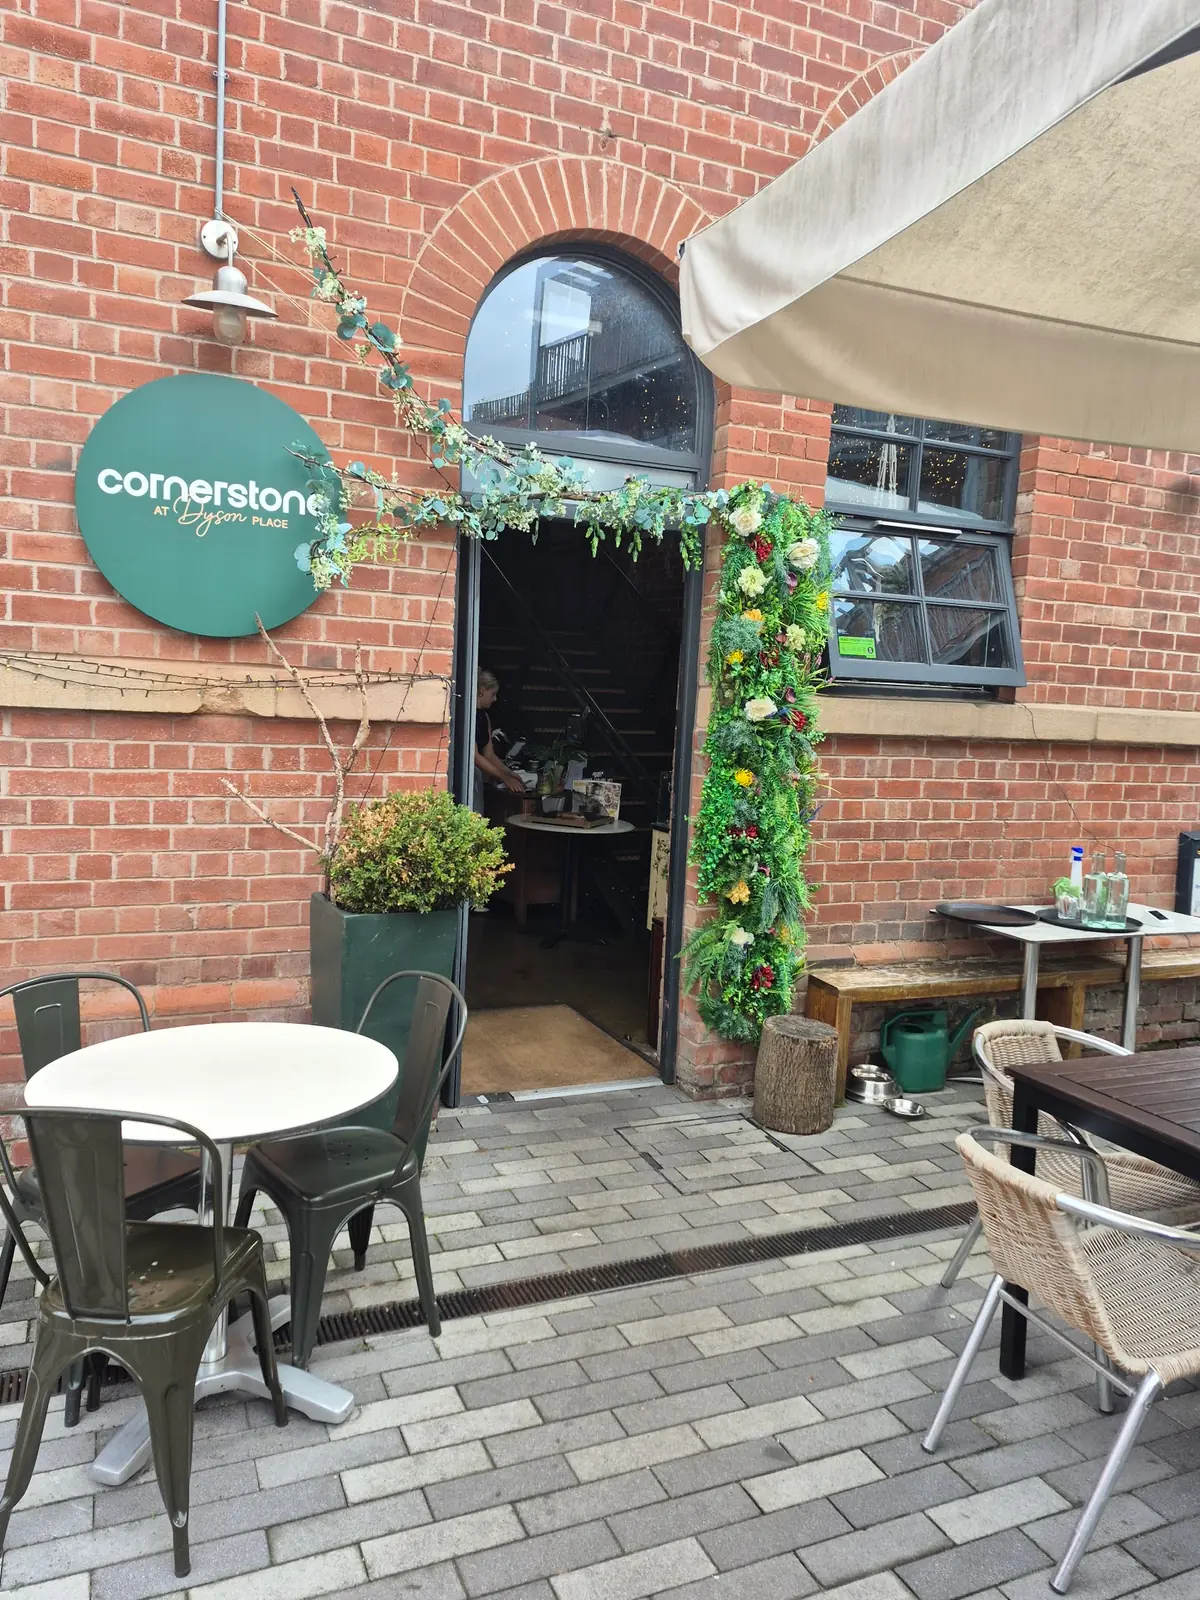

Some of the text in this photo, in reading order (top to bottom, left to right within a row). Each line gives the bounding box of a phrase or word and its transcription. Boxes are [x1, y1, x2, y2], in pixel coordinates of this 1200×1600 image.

[153, 493, 289, 537] AT Dyson PLACE
